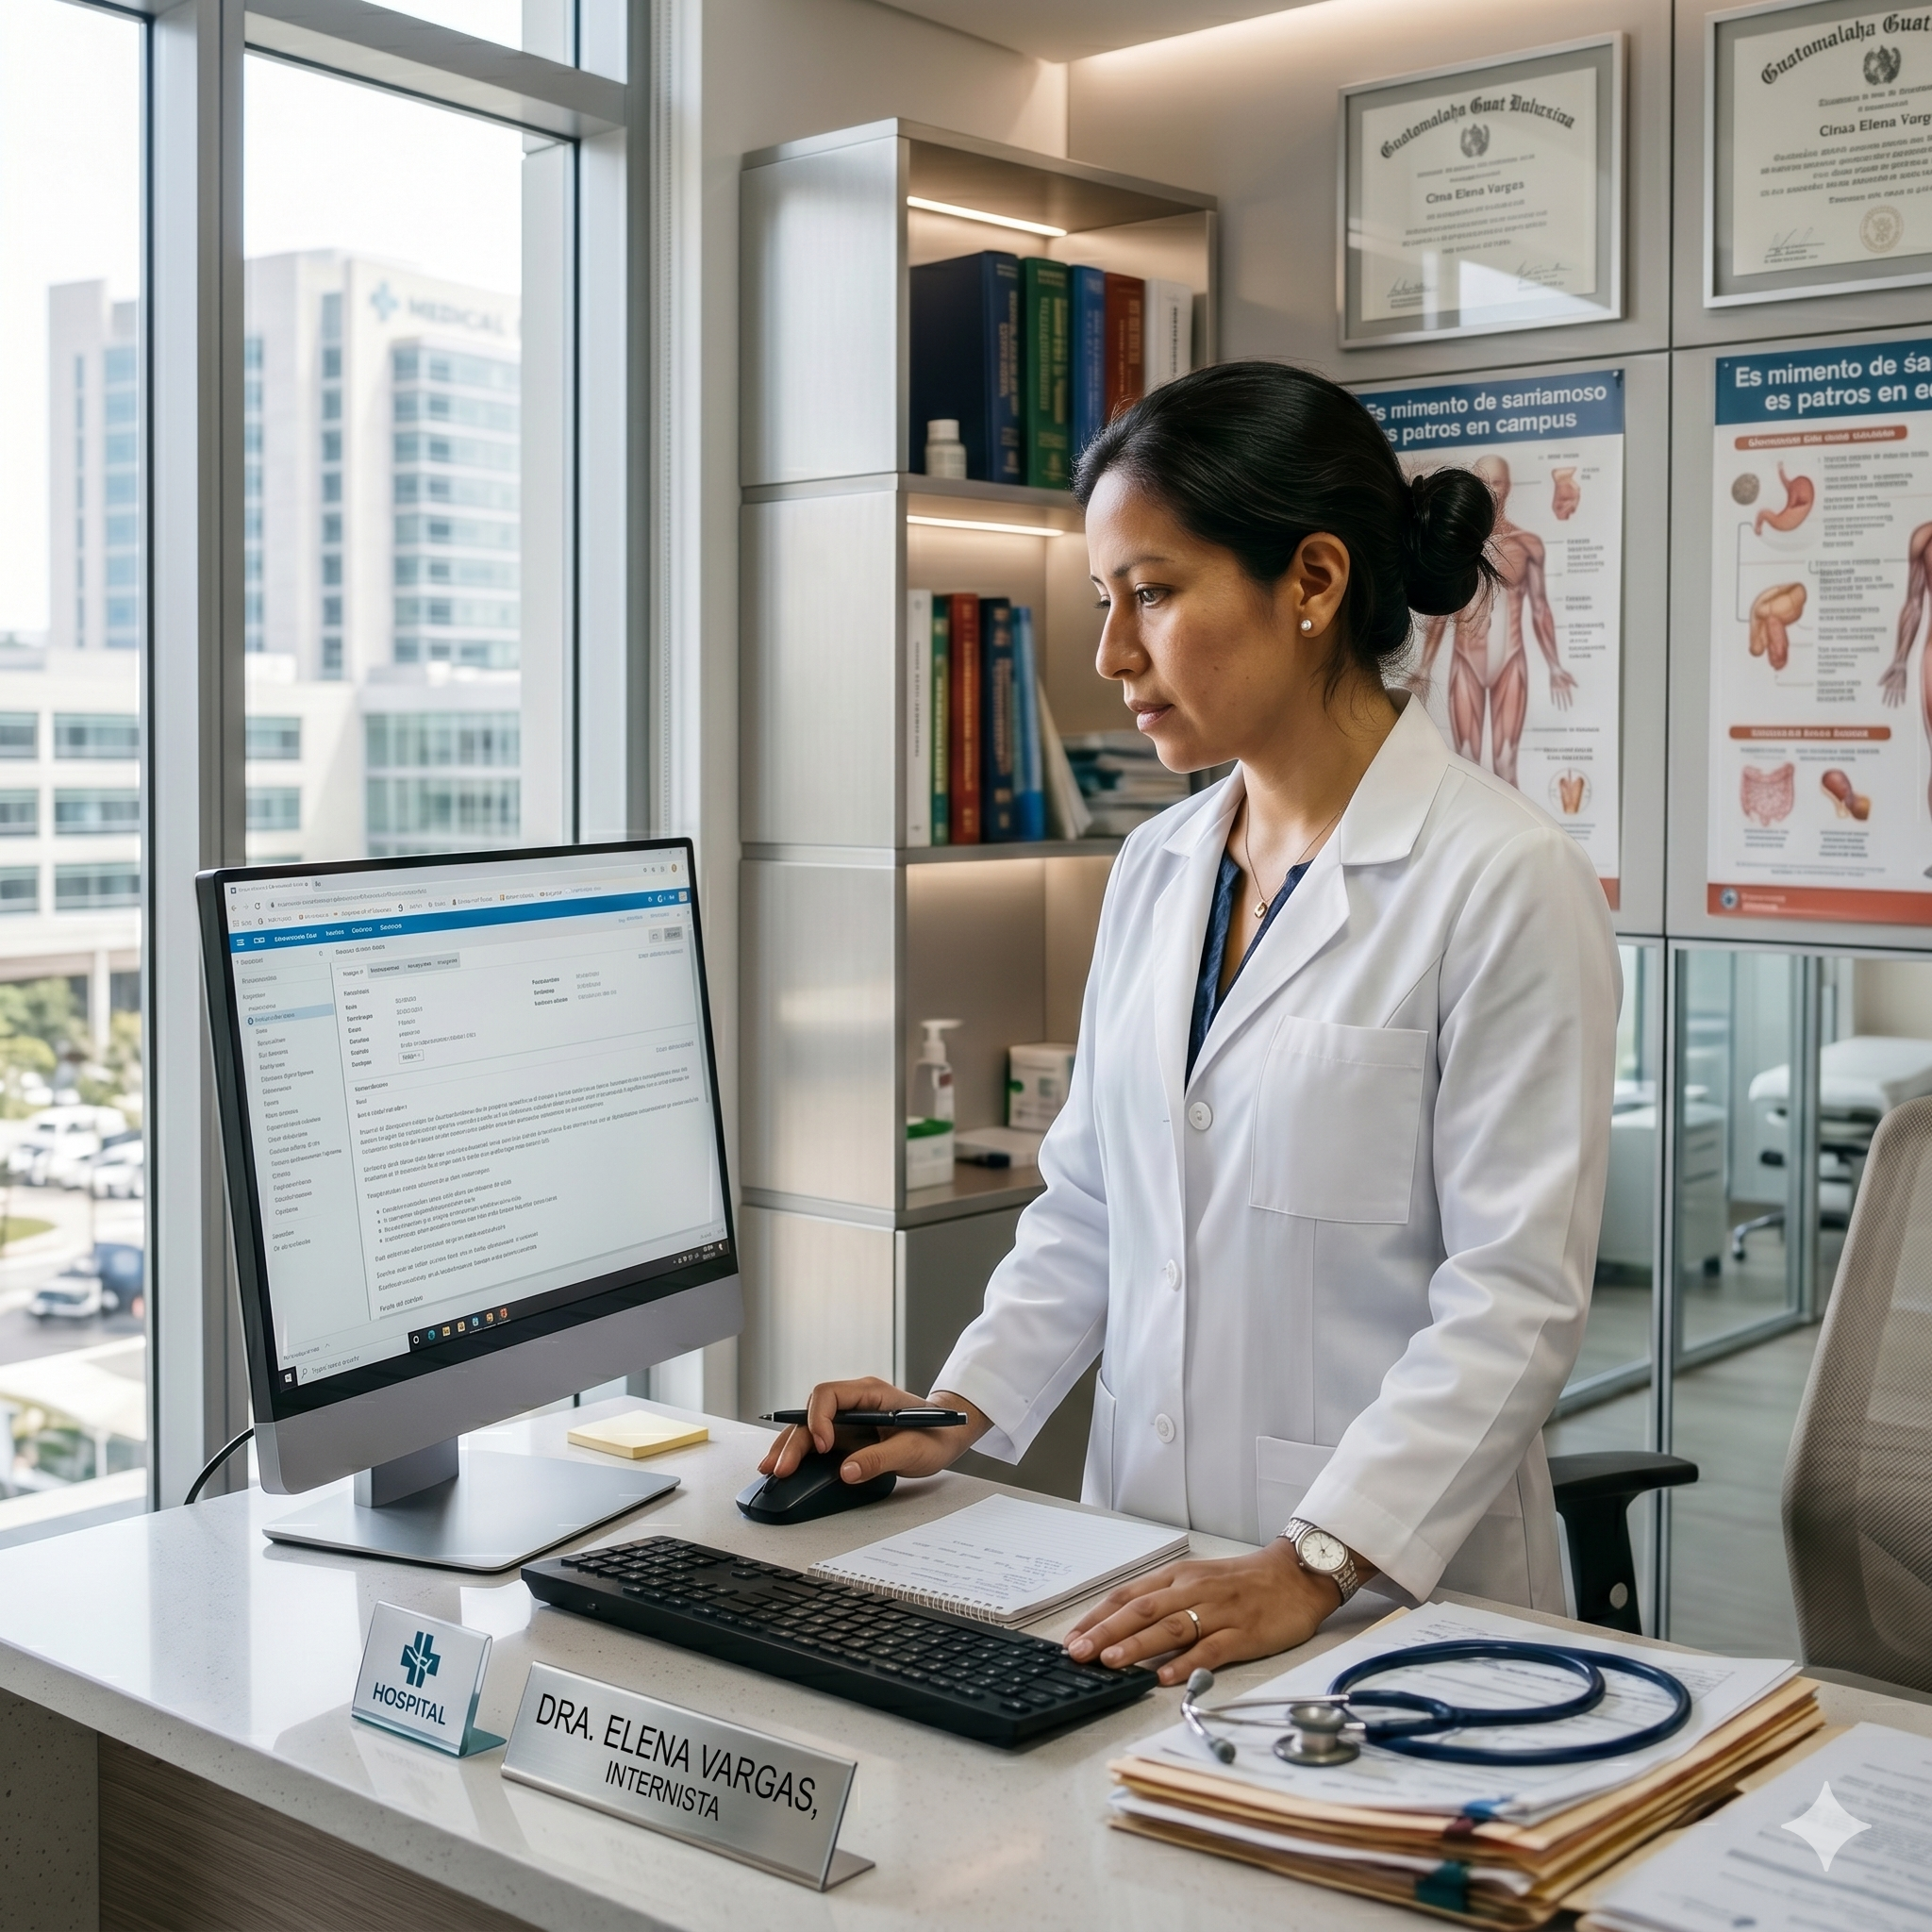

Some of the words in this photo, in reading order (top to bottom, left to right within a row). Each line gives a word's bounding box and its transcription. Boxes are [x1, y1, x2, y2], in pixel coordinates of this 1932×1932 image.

[1859, 118, 1896, 131] Elena
[1901, 113, 1932, 126] Varg
[1735, 366, 1762, 388] Es
[1767, 359, 1862, 385] mimento
[1869, 355, 1897, 376] de
[1904, 351, 1932, 374] śa
[1391, 399, 1469, 419] mimento
[1474, 392, 1497, 411] de
[1764, 392, 1791, 411] es
[1797, 387, 1872, 415] patros
[1877, 384, 1907, 402] en
[1402, 422, 1461, 446] patros
[1466, 419, 1490, 435] en
[1495, 412, 1577, 434] campus
[373, 1681, 446, 1725] HOSPITAL
[535, 1692, 594, 1741] DRA.
[603, 1713, 690, 1774] ELENA
[702, 1744, 818, 1821] VARGAS,
[605, 1760, 719, 1822] INTERNISTA
